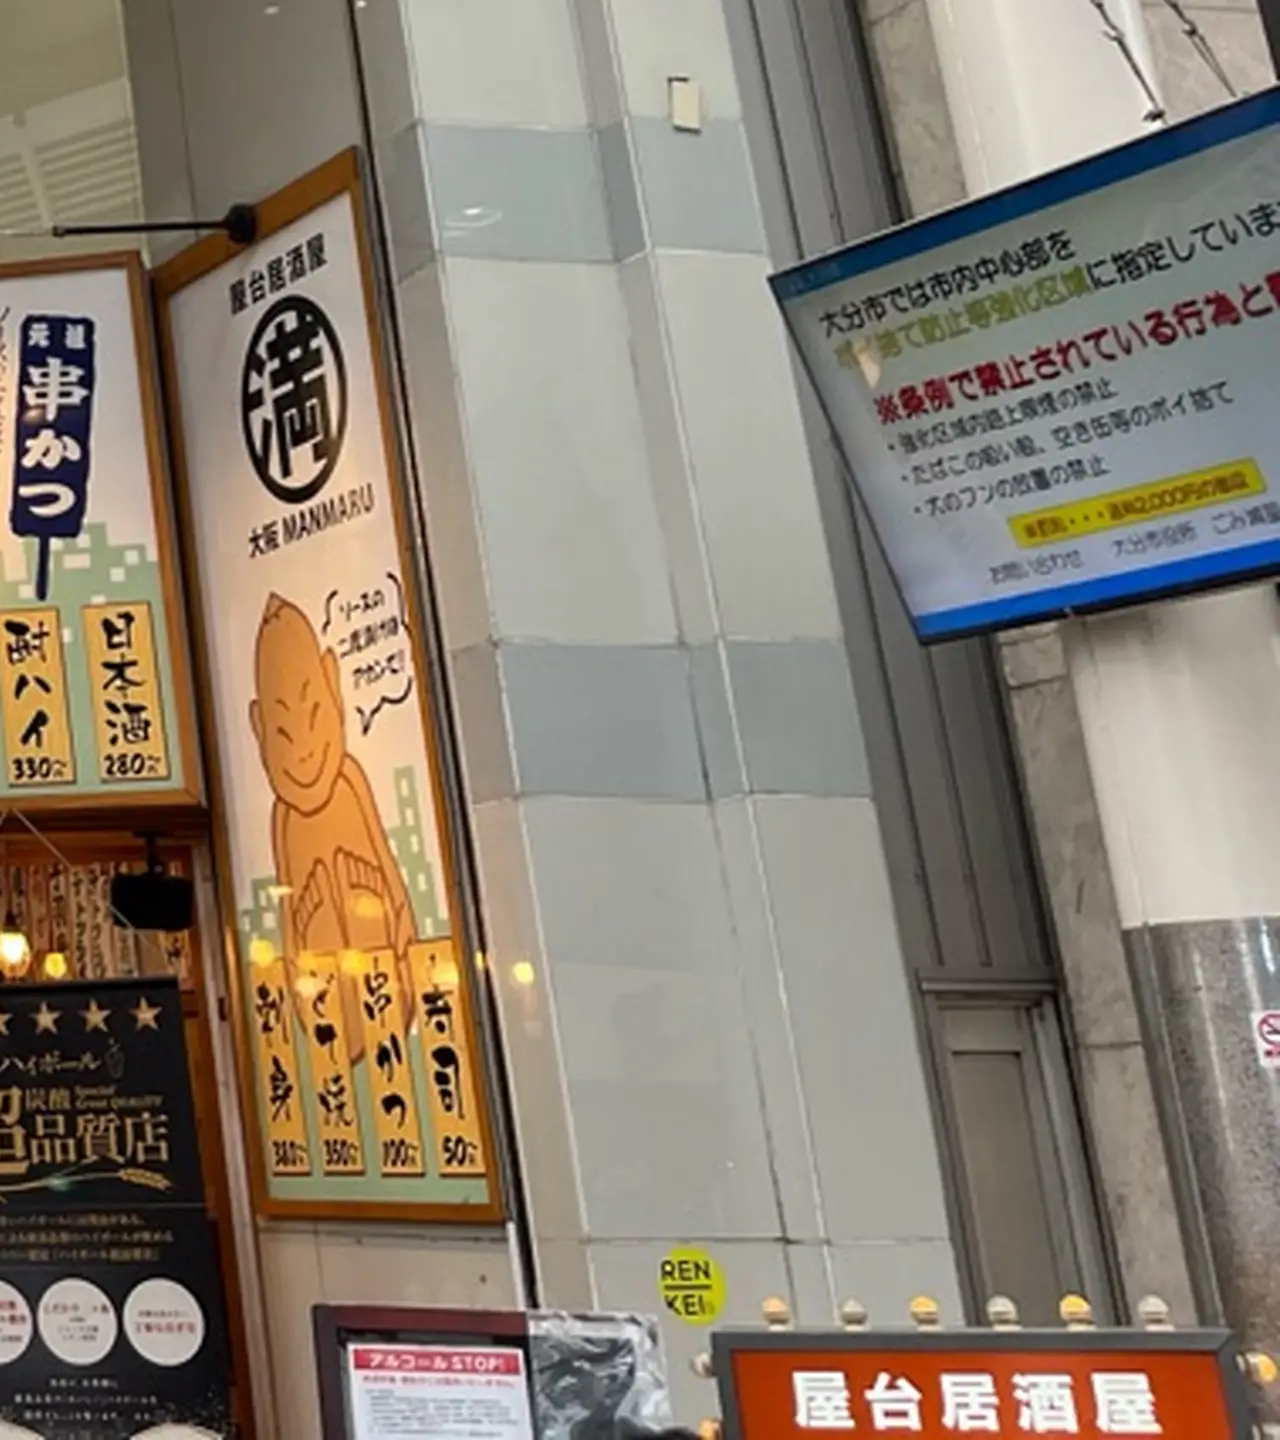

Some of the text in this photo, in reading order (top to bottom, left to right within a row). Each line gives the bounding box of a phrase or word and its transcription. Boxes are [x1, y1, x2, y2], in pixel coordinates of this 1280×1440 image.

[229, 233, 328, 316] 屋台居酒屋
[18, 356, 90, 518] 串かつ
[241, 293, 348, 503] 満
[282, 483, 376, 545] MANMARU
[4, 620, 51, 749] 酎ハイ
[101, 611, 151, 746] 日本酒
[660, 1259, 712, 1282] REN
[791, 1370, 1164, 1435] 屋台居酒屋
